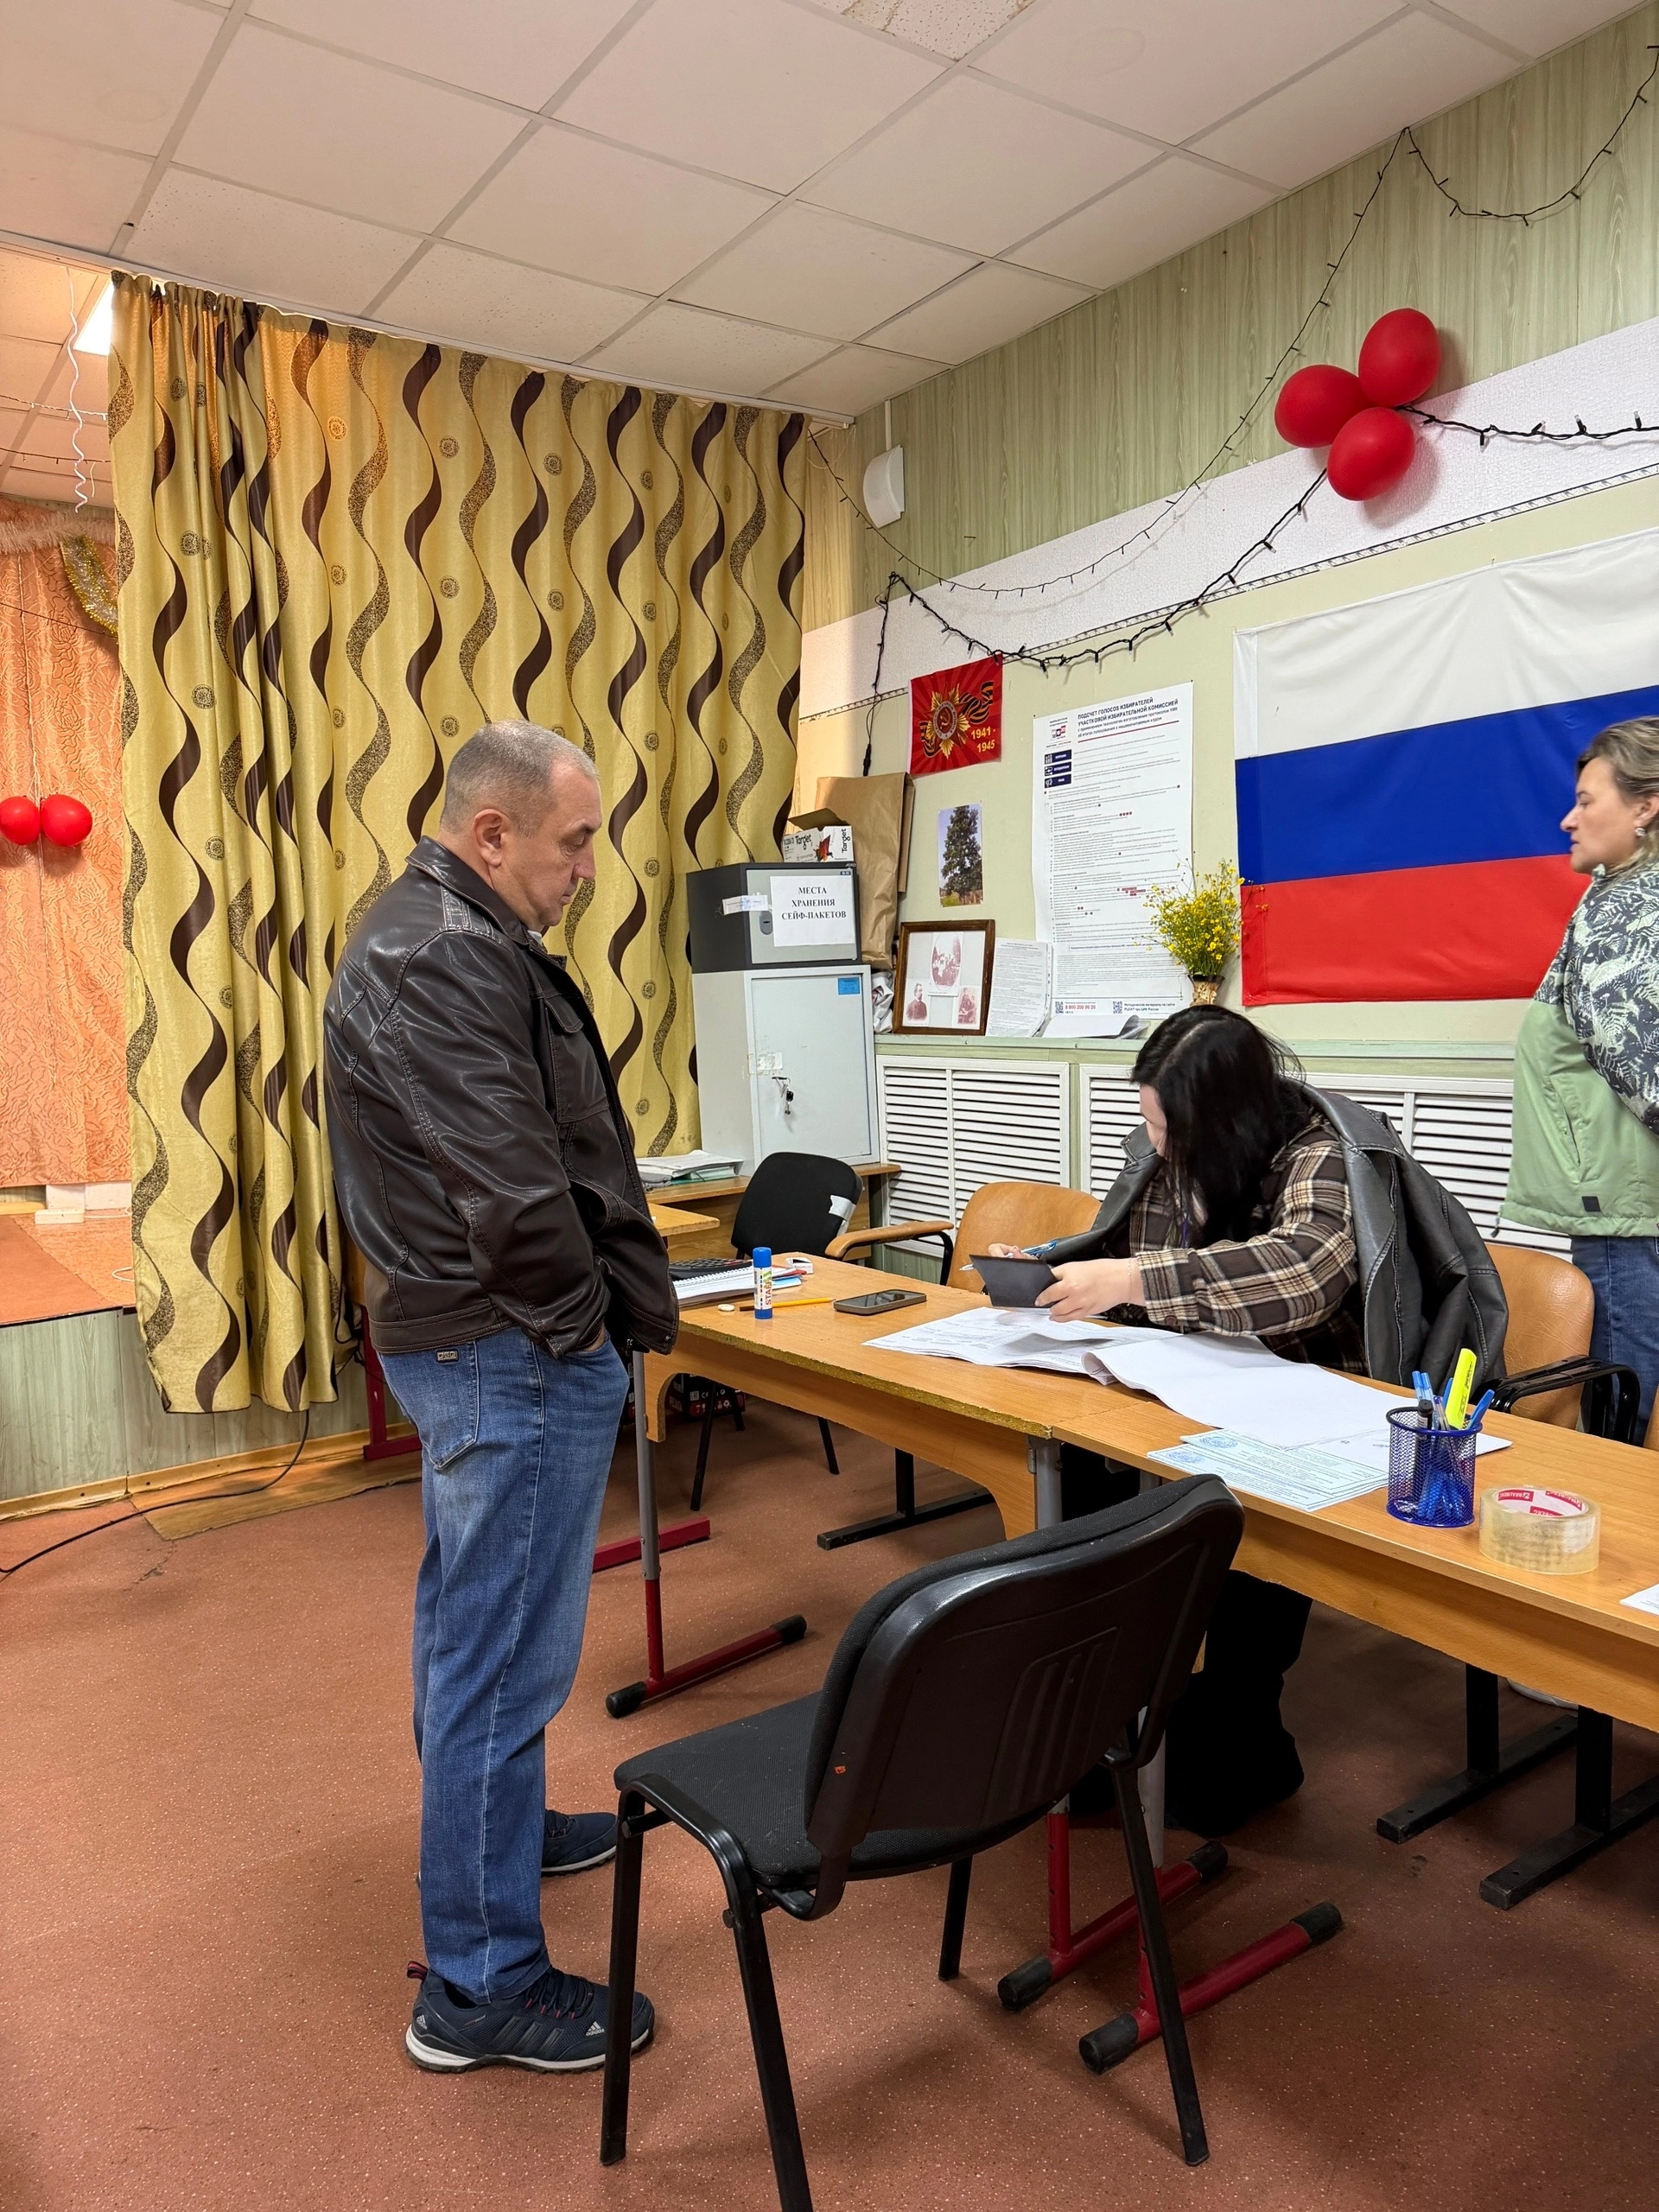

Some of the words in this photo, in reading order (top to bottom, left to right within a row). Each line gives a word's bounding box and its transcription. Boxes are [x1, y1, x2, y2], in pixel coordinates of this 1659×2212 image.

[1078, 710, 1097, 719] ПОДСЧЕТ
[1098, 705, 1119, 715] ГОЛОСОВ
[1120, 696, 1153, 709] ИЗБИРАТЕЛЕЙ
[1078, 715, 1106, 726] УЧАСТКОВОЙ
[1108, 705, 1147, 720] ИЗБИРАТЕЛЬНОЙ
[1148, 698, 1178, 710] КОМИССИЕЙ
[976, 740, 995, 753] 1945
[795, 834, 811, 850] Target
[842, 829, 850, 853] Target
[792, 899, 835, 907] ХРАНЕНИЯ
[782, 911, 846, 919] СЕЙФ-ПАКЕТОВ
